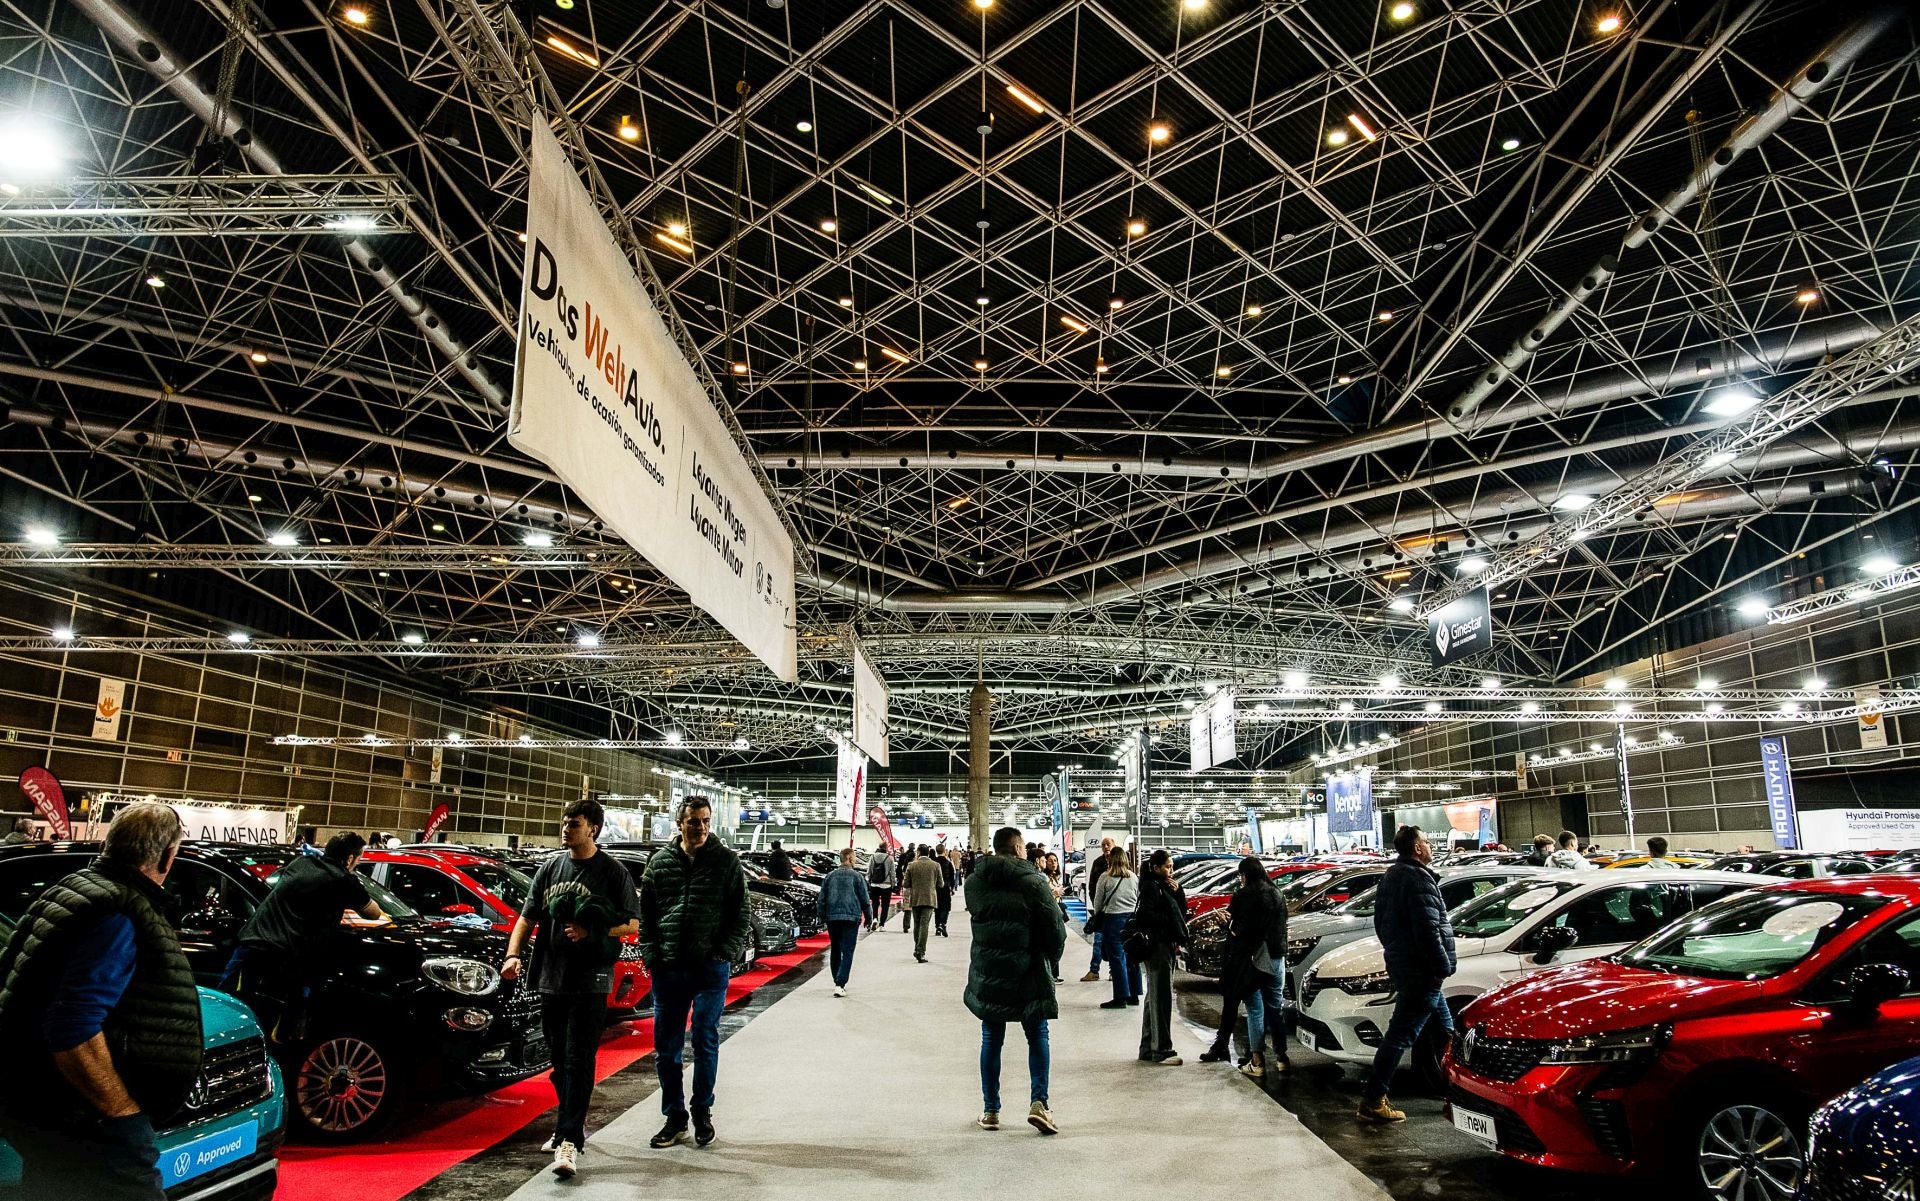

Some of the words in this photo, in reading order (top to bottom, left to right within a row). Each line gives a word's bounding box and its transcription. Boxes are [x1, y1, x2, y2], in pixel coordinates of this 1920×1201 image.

[530, 236, 579, 341] Das
[585, 301, 666, 455] WeltAuto.
[577, 375, 590, 401] de
[591, 395, 623, 439] ocasión
[623, 432, 665, 488] garantizados
[724, 495, 747, 546] Wagen
[722, 534, 744, 579] Motor
[1451, 616, 1482, 640] Ginestar
[1846, 811, 1883, 820] Hyundai
[1884, 811, 1920, 819] Promise
[1467, 1115, 1487, 1134] new
[196, 1136, 242, 1165] Approved
